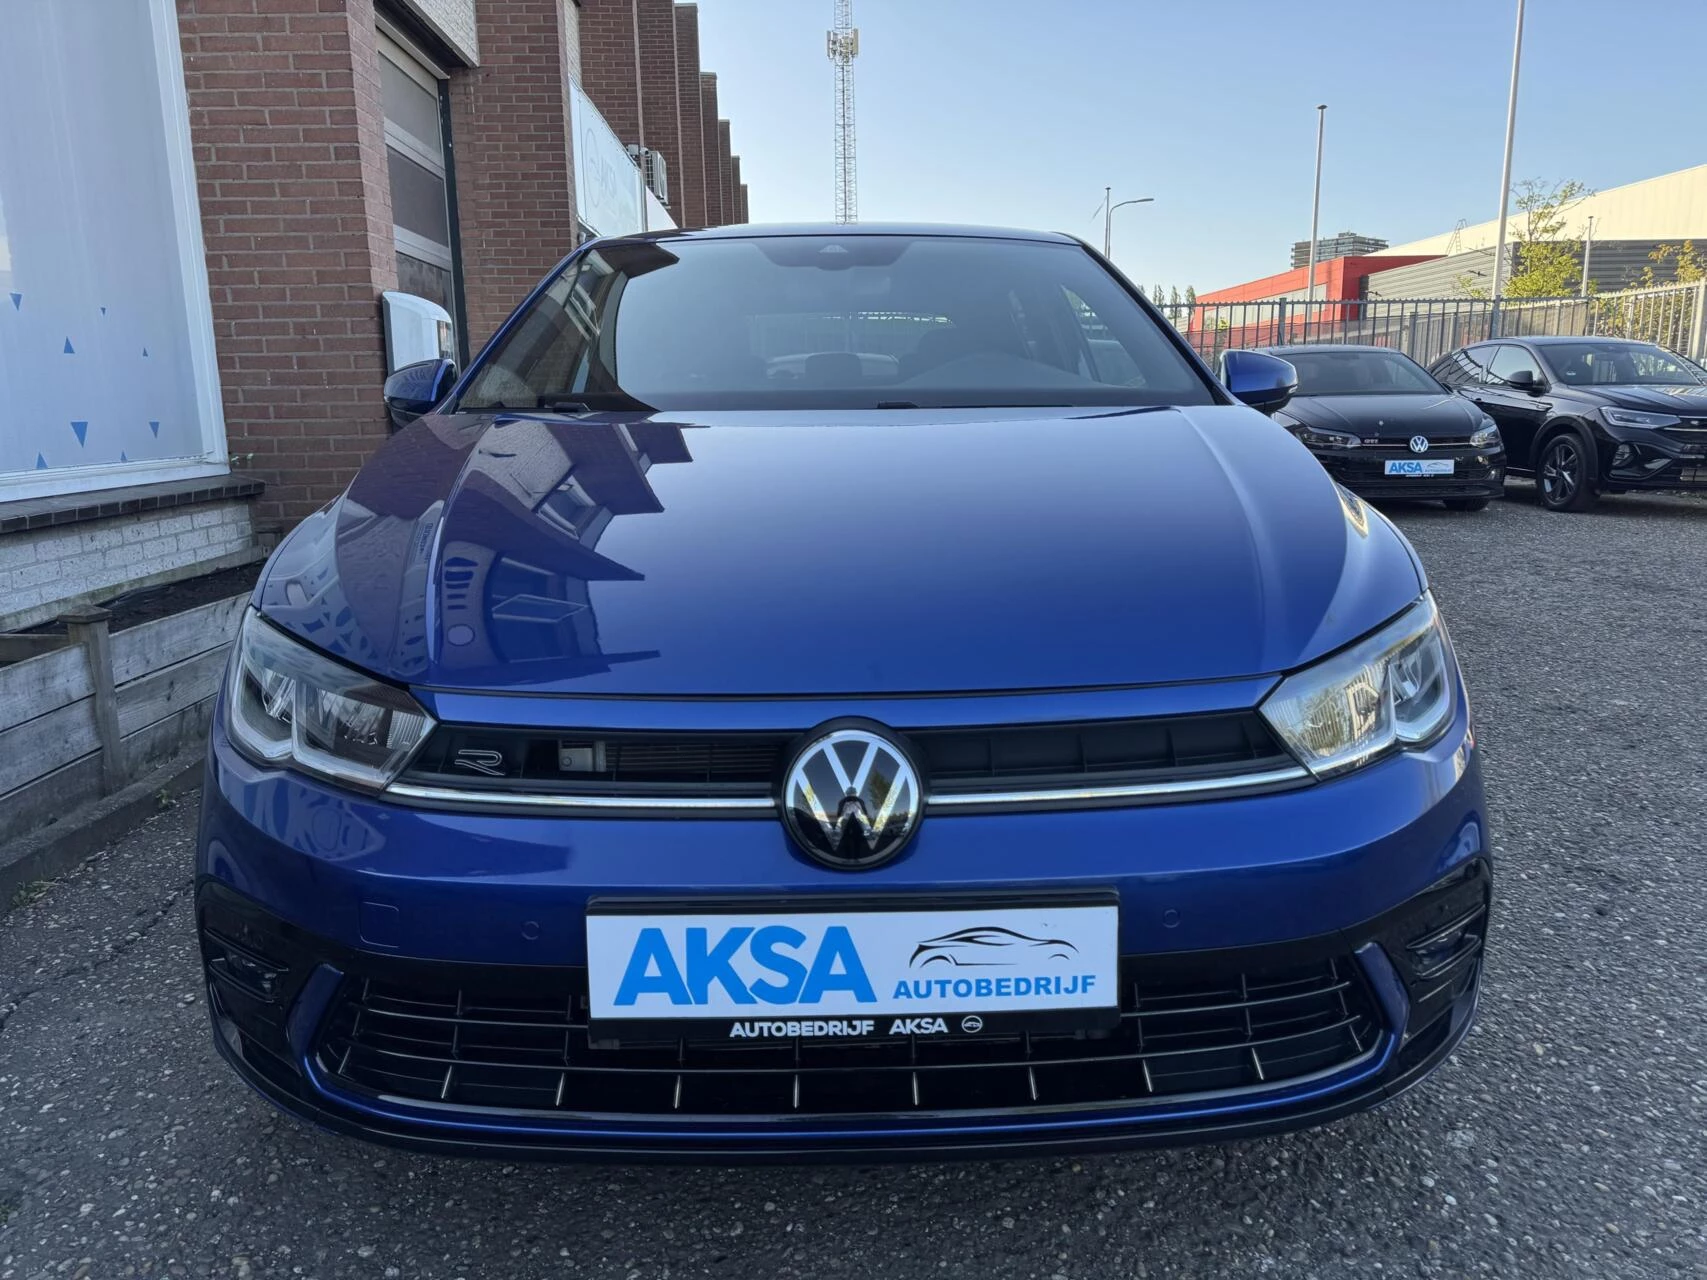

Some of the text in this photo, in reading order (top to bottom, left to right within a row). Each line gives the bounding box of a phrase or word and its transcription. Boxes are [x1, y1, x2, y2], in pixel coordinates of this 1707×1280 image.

[1388, 461, 1423, 474] AKSA
[613, 925, 1096, 1006] AKSA AUTOBEDRIJF
[729, 1017, 949, 1038] AUTOBEDRIJF AKSA
